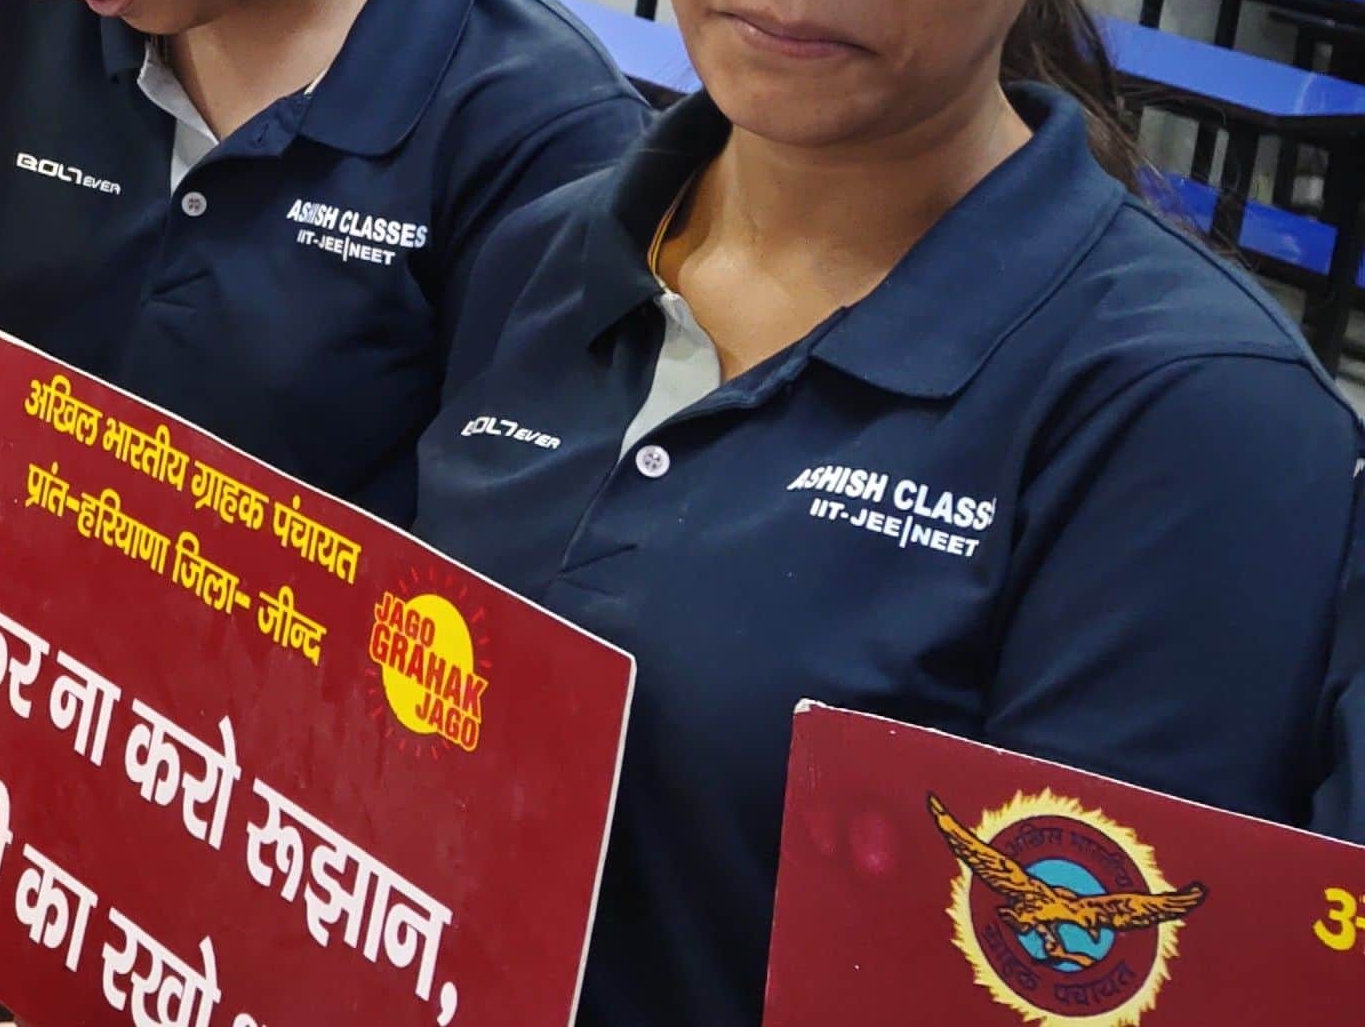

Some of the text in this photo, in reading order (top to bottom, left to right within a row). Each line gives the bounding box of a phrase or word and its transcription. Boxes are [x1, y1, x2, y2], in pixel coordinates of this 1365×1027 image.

[338, 210, 428, 248] CLASSES
[24, 374, 104, 446] अखिल
[102, 417, 190, 492] भारतीय
[190, 459, 270, 530] ग्राहक
[272, 494, 362, 585] पंचायत
[786, 465, 997, 531] ASHISH CLASS
[24, 461, 327, 666] प्रांत-हरियाणा जिला- जीन्द
[375, 592, 436, 648] JAGO
[370, 622, 485, 717] GRAHAK
[414, 696, 479, 750] JAGO
[49, 650, 122, 766] ना
[124, 698, 242, 850] करो
[246, 777, 458, 1027] रूझान,
[15, 843, 99, 972] का
